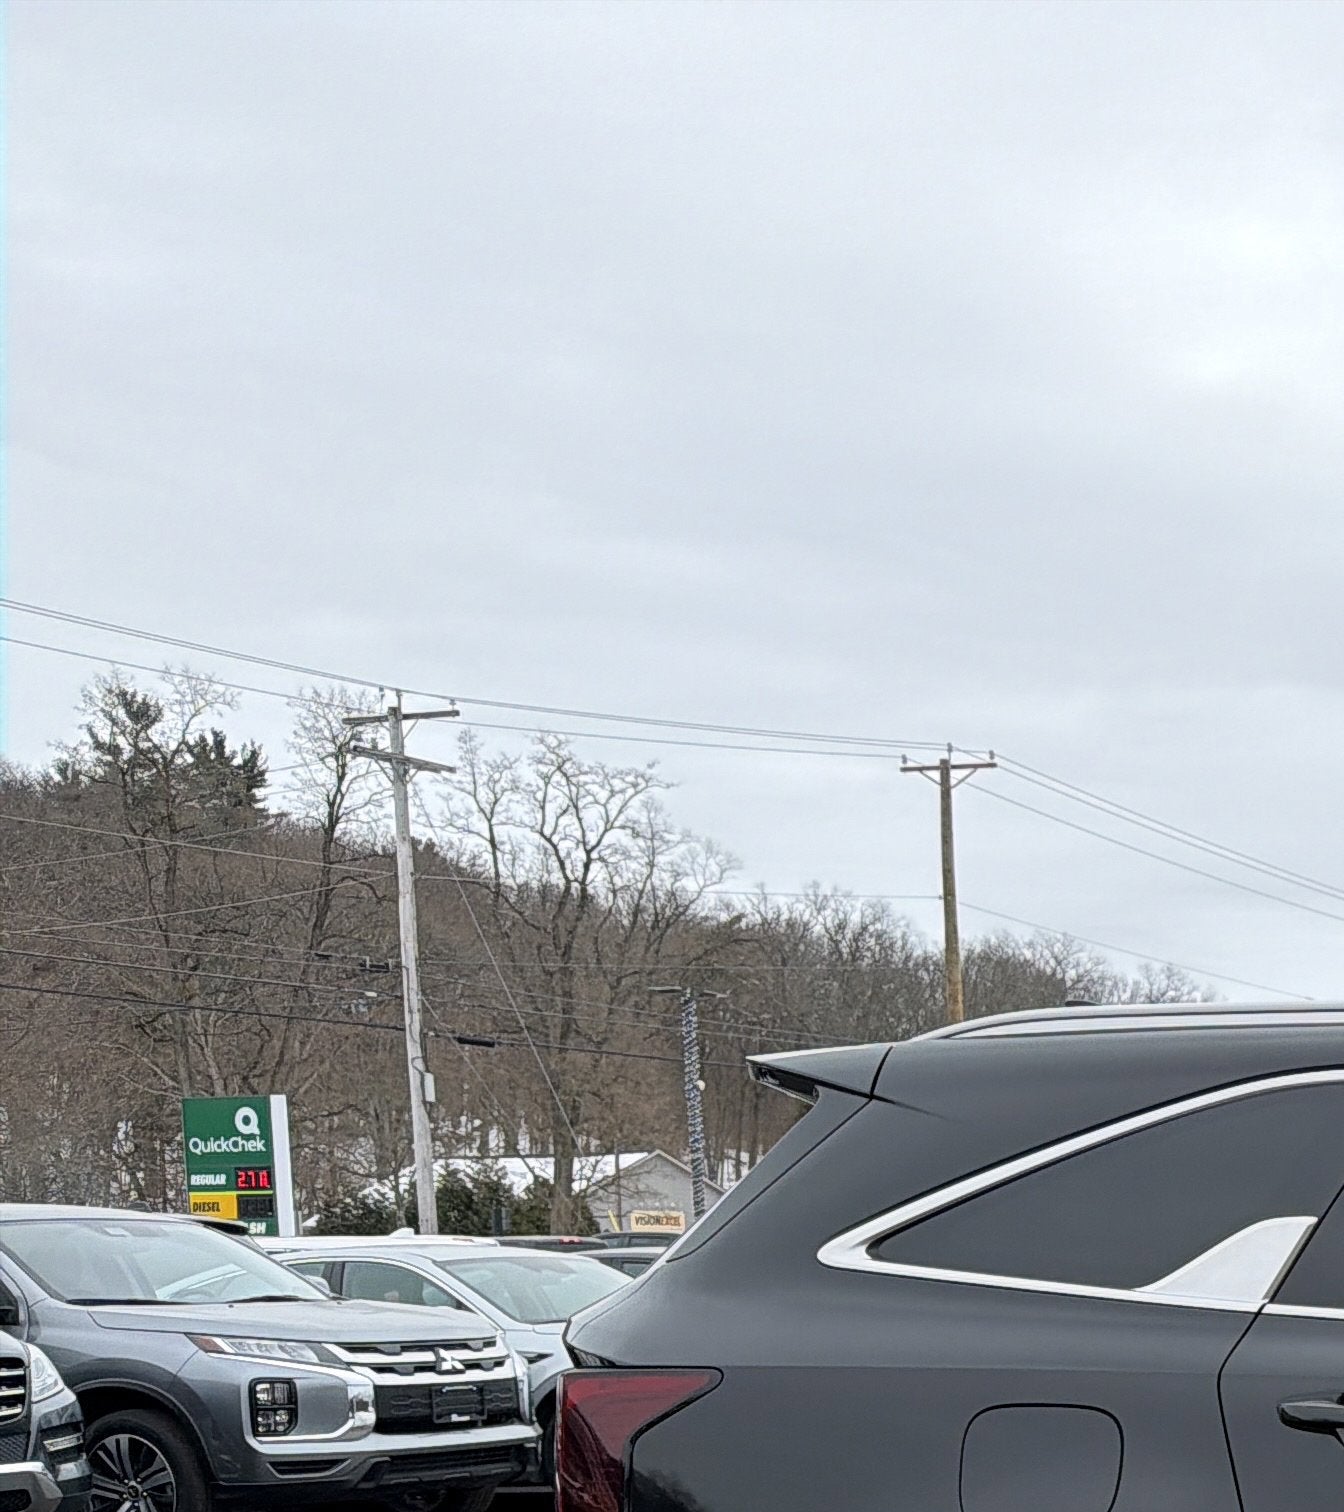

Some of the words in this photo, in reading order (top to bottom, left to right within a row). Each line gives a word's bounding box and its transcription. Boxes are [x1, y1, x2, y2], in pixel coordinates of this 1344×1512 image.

[189, 1136, 266, 1155] QuickChek
[190, 1173, 226, 1186] REGULAR
[193, 1201, 221, 1213] DIESEL
[248, 1222, 266, 1235] SH
